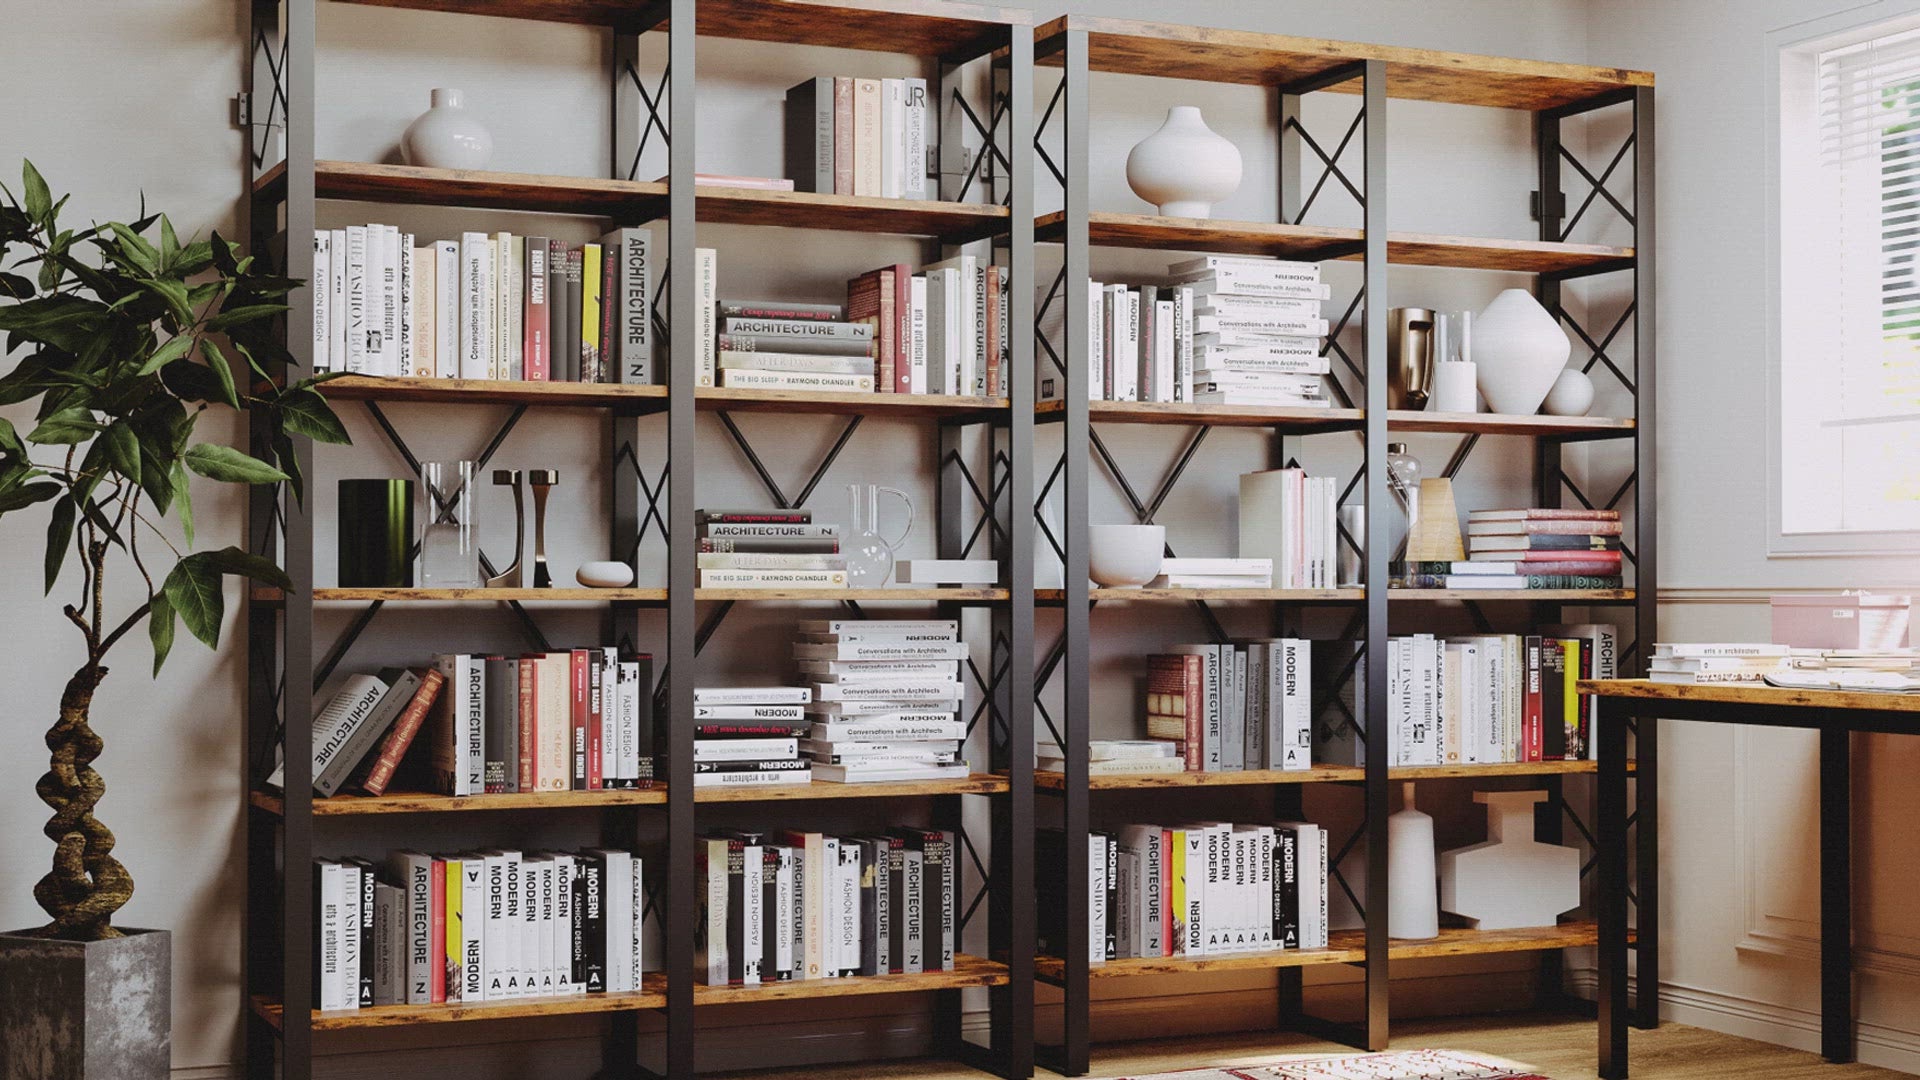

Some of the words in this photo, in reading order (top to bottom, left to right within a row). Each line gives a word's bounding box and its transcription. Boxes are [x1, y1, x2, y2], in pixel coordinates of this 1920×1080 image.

[905, 86, 925, 108] JR
[911, 132, 919, 154] CHANGE
[351, 229, 362, 260] THE
[316, 268, 324, 306] FASHION
[470, 258, 479, 293] Architects
[629, 238, 645, 345] ARCHITECTURE
[351, 264, 362, 328] FASHION
[976, 267, 984, 361] ARCHITECTURE
[316, 308, 324, 342] DESIGN
[470, 310, 479, 360] Conversations
[734, 322, 835, 336] ARCHITECTURE
[786, 377, 820, 385] RAYMOND
[821, 378, 854, 386] CHANDLER
[714, 527, 805, 536] ARCHITECTURE
[907, 687, 940, 695] Architects
[1287, 646, 1296, 696] MODERN
[470, 668, 480, 757] ARCHITECTURE
[623, 695, 631, 728] FASHION
[755, 709, 798, 717] MODERN
[1209, 653, 1218, 737] ARCHITECTURE
[1403, 669, 1411, 723] FASHION
[314, 686, 380, 766] ARCHITECTURE
[623, 730, 631, 757] DESIGN
[847, 728, 894, 736] Conversations
[759, 761, 805, 769] MODERN
[1109, 841, 1117, 890] MODERN
[1209, 835, 1217, 883] MODERN
[1221, 831, 1230, 880] MODERN
[1236, 840, 1244, 885] MODERN
[1284, 838, 1293, 883] MODERN
[345, 869, 356, 901] THE
[491, 865, 501, 919] MODERN
[508, 862, 518, 916] MODERN
[526, 871, 535, 922] MODERN
[543, 869, 551, 920] MODERN
[559, 865, 567, 918] MODERN
[588, 868, 598, 919] MODERN
[844, 878, 852, 914] FASHION
[943, 841, 951, 933] ARCHITECTURE
[1095, 868, 1103, 920] FASHION
[1149, 835, 1158, 922] ARCHITECTURE
[326, 904, 337, 918] arts
[364, 872, 374, 927] MODERN
[414, 865, 427, 964] ARCHITECTURE
[794, 857, 802, 944] ARCHITECTURE
[909, 860, 919, 940] ARCHITECTURE
[345, 903, 356, 963] FASHION
[844, 916, 852, 946] DESIGN
[1191, 901, 1199, 948] MODERN
[1209, 935, 1217, 945] A
[1223, 934, 1229, 943] A
[1237, 934, 1244, 943] A
[1250, 933, 1256, 942] A
[1263, 932, 1269, 942] A
[1286, 930, 1295, 940] A
[326, 930, 337, 973] architecture
[468, 940, 479, 993] MODERN
[345, 967, 356, 1007] BOOK
[492, 978, 501, 989] A
[509, 977, 517, 987] A
[526, 977, 535, 987] A
[543, 976, 551, 987] A
[560, 975, 567, 985] A
[590, 972, 599, 984] A
